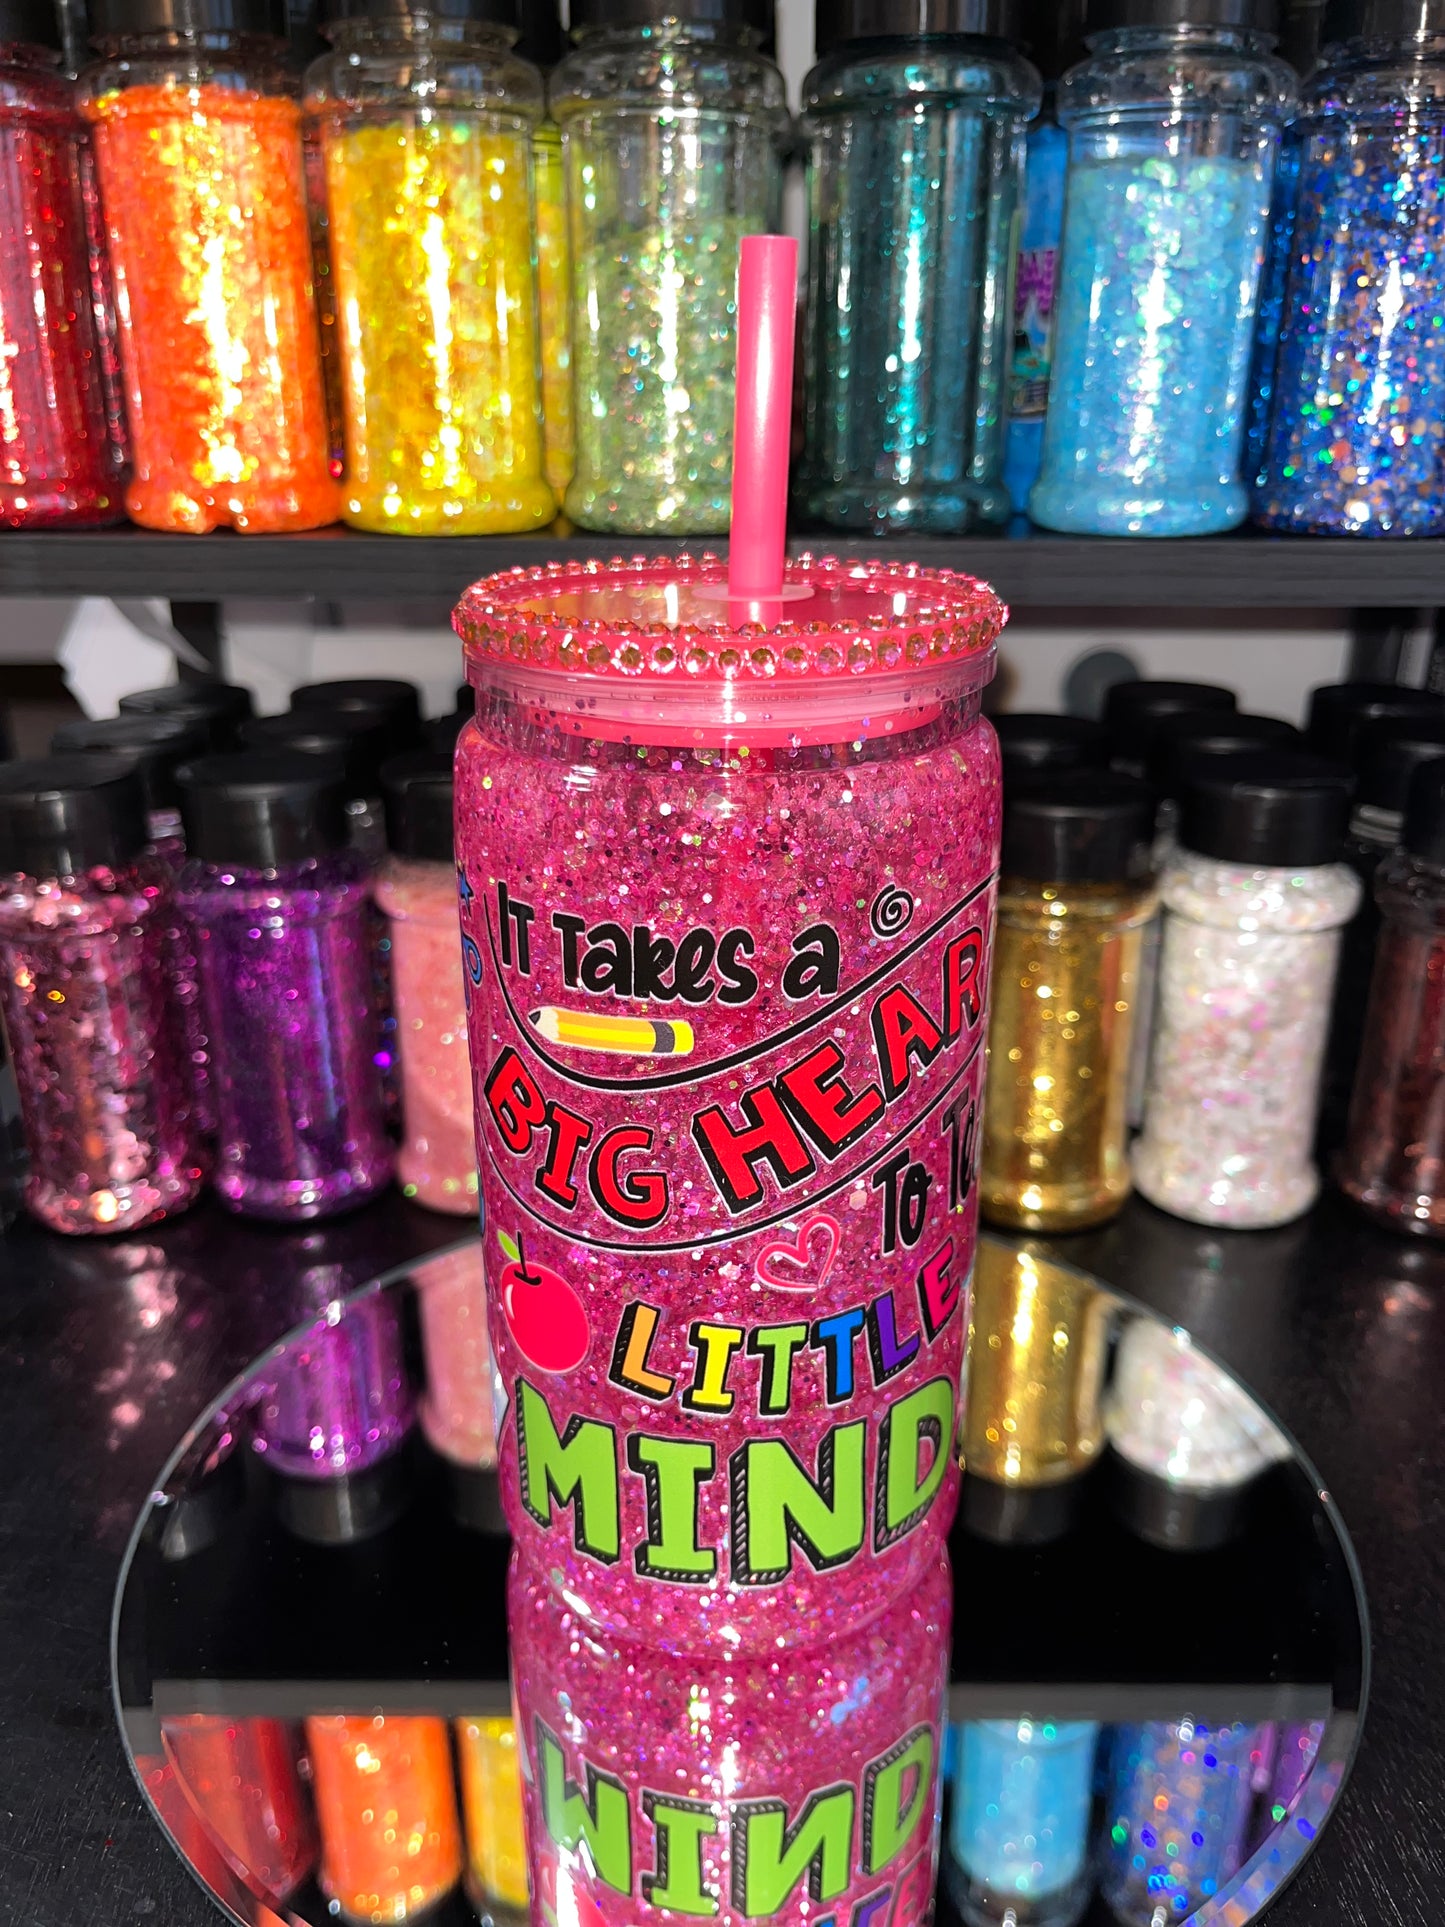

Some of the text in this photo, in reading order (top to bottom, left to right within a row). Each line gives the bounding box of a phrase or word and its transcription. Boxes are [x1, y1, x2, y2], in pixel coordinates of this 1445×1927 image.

[782, 922, 841, 996] a
[484, 927, 983, 1230] BIG HEAR
[608, 1235, 961, 1415] LITTLE
[515, 1375, 956, 1585] MIND
